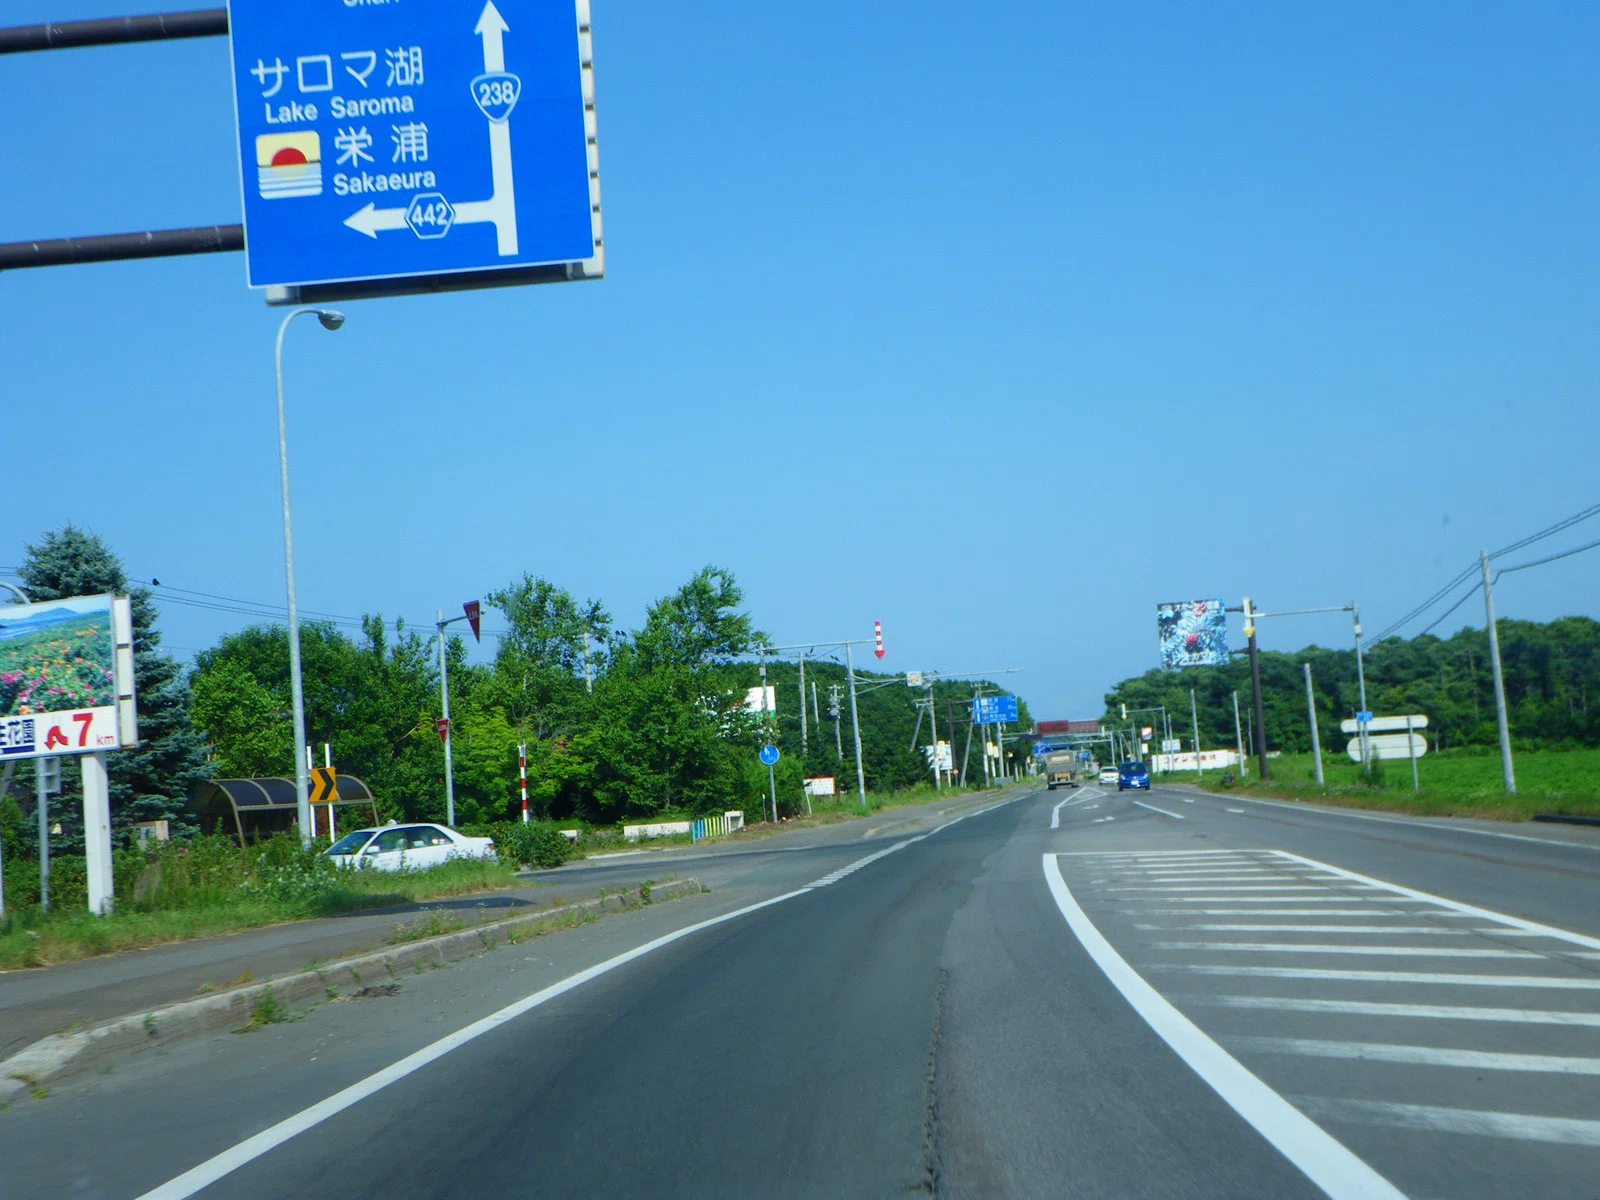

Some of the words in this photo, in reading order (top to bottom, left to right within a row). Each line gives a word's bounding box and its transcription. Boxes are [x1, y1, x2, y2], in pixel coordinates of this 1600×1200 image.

[251, 46, 424, 97] サロマ湖
[479, 82, 515, 106] 238
[265, 101, 318, 124] Lake
[330, 96, 415, 119] Saroma
[333, 170, 437, 195] Sakaeura
[411, 205, 447, 227] 442
[73, 713, 93, 746] 7
[97, 735, 115, 745] km
